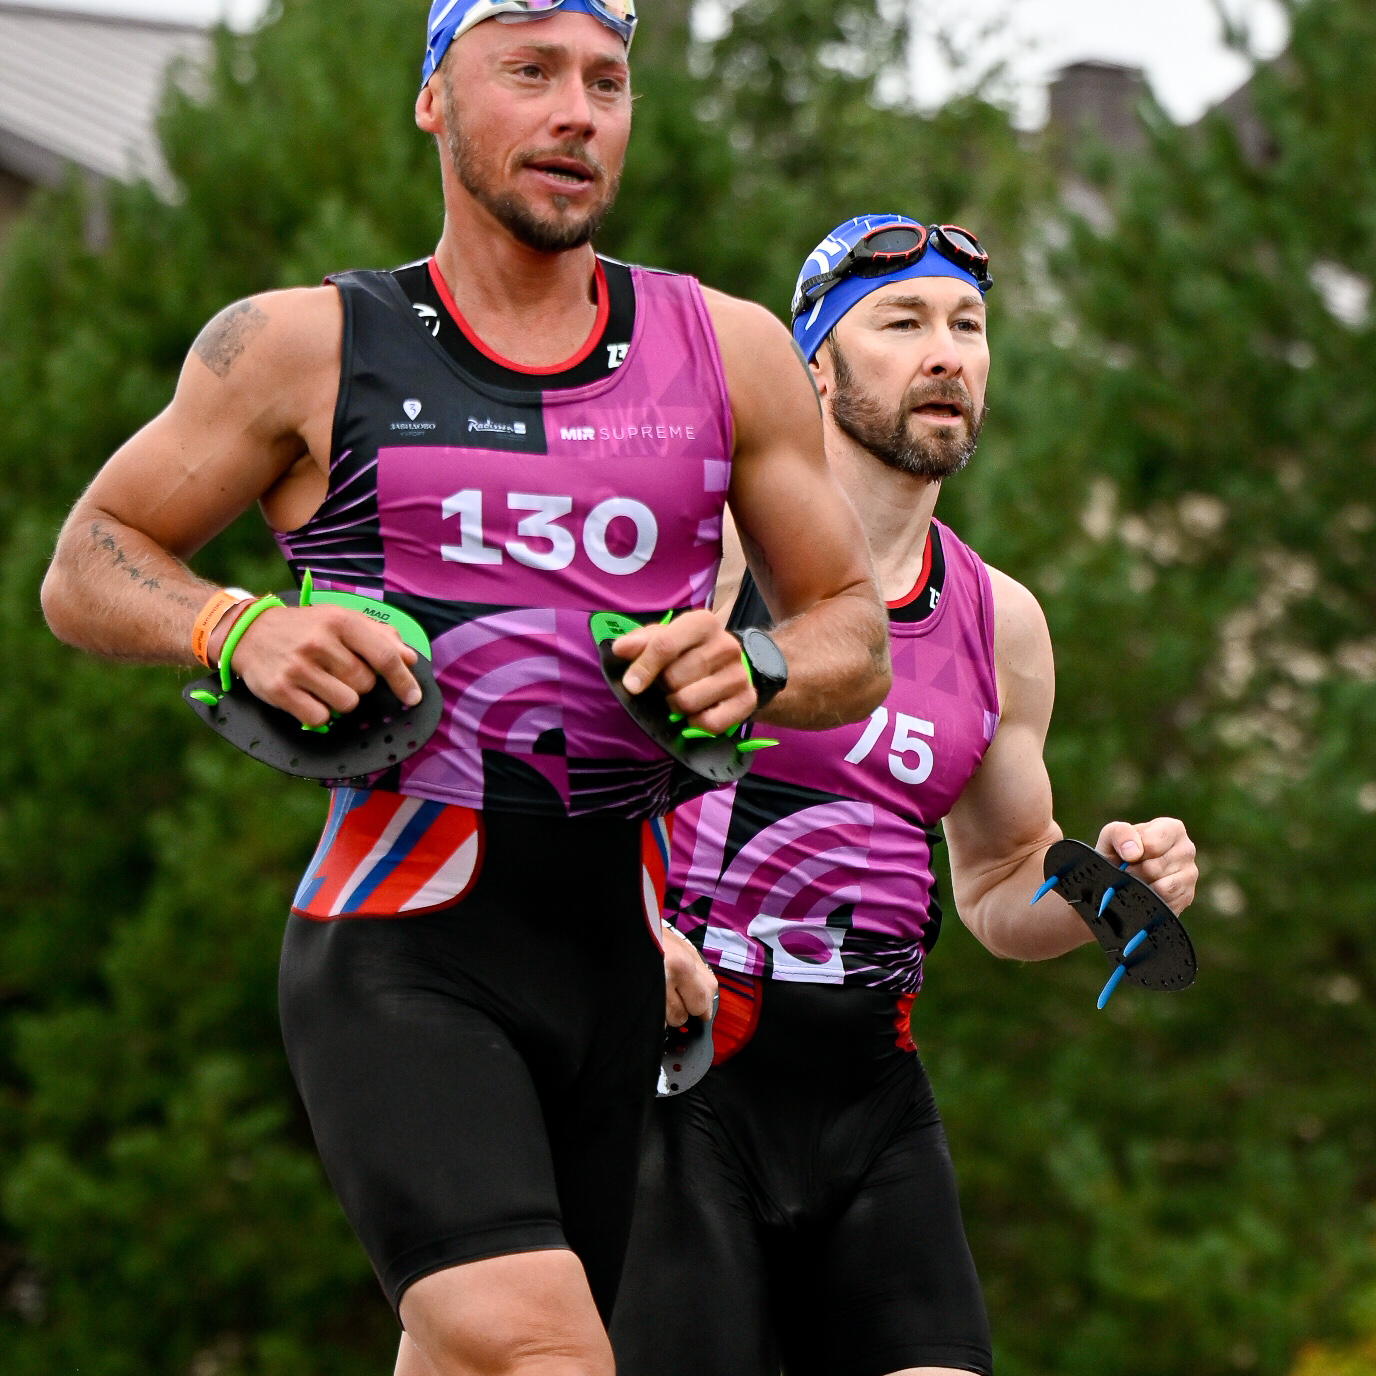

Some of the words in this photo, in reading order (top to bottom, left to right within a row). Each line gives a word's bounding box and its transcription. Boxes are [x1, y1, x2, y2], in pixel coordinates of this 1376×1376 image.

[560, 427, 595, 441] MIR
[600, 426, 695, 440] SUPREME
[440, 488, 658, 576] 130
[362, 607, 391, 621] MAD
